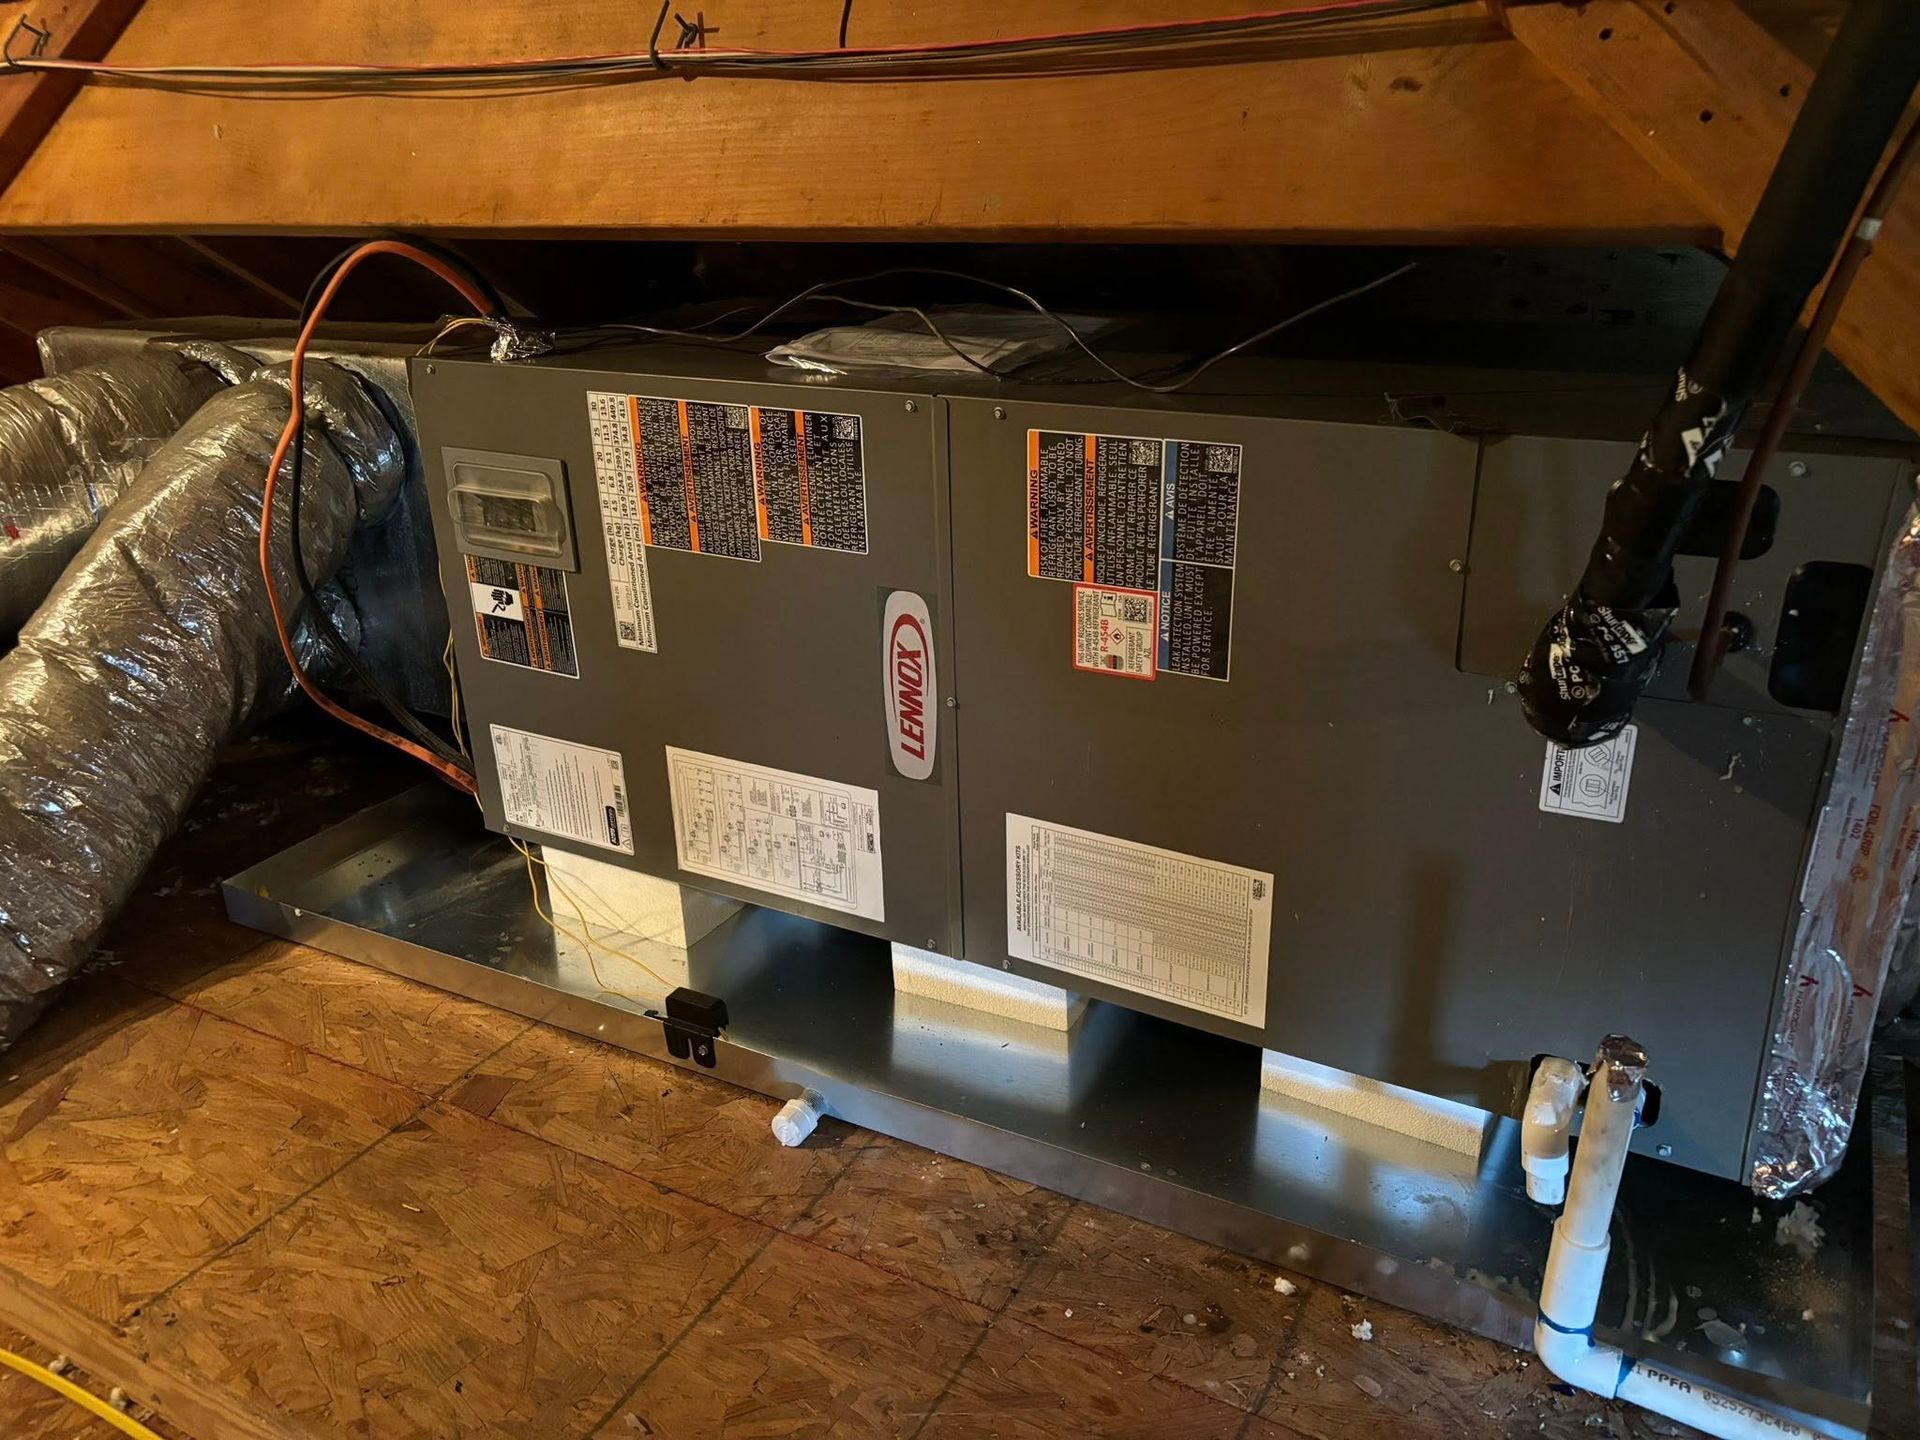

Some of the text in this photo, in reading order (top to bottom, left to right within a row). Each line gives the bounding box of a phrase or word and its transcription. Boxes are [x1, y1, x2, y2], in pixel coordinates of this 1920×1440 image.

[608, 397, 617, 419] 449.8
[618, 401, 626, 418] 41.8
[611, 422, 619, 444] 374.8
[1065, 438, 1073, 457] NOT
[614, 447, 622, 469] 299.9
[623, 451, 631, 468] 27.9
[634, 443, 646, 496] WARNING
[753, 442, 764, 495] WARNING
[1065, 461, 1073, 475] DO
[590, 401, 616, 564] Charge (lb) 10 15 20 25 30
[617, 472, 625, 493] 224.9
[682, 434, 695, 512] AVERTISSEMENT
[797, 432, 808, 514] AVERTISSEMENT
[1057, 491, 1064, 502] BY
[1085, 458, 1094, 549] AVERTISSEMENT
[1136, 466, 1146, 513] PERFORER
[620, 496, 628, 516] 149.9
[629, 500, 637, 516] 13.9
[1048, 444, 1056, 576] REFRIGERANT USED. TO BE
[1056, 507, 1064, 531] ONLY
[1065, 479, 1073, 538] PERSONNEL.
[1074, 436, 1083, 579] PUNCTURE REFRIGERANT TUBING.
[1104, 440, 1117, 584] UTILISÉ INFLAMMABLE. SEUL
[1145, 478, 1157, 548] RÉFRIGÉRANT.
[614, 522, 622, 536] (kg)
[623, 522, 632, 540] (ft2)
[631, 522, 641, 541] (m2)
[1124, 468, 1136, 586] FORMÉ PEUT RÉPARER CE
[1136, 515, 1145, 532] PAS
[616, 537, 626, 566] Charge
[634, 541, 642, 560] Area
[1040, 538, 1047, 552] OF
[1116, 513, 1125, 569] PERSONNEL
[1136, 534, 1144, 546] NE
[1096, 553, 1106, 582] RISQUE
[1115, 571, 1124, 585] UN
[1146, 553, 1155, 576] TUBE
[1184, 565, 1194, 592] MUST
[628, 561, 640, 608] Conditioned
[637, 561, 649, 609] Conditioned
[1145, 579, 1154, 589] LE
[1160, 590, 1170, 630] NOTICE
[1171, 563, 1184, 670] LEAK DETECTION SYSTEM
[1191, 566, 1204, 673] BE POWERED EXCEPT
[634, 609, 644, 645] Minimum
[643, 610, 653, 647] Minimum
[1200, 605, 1212, 675] FOR SERVICE.
[1569, 665, 1583, 682] PC
[896, 641, 925, 760] LENNOX
[1553, 749, 1566, 784] IMPORT
[1850, 818, 1863, 840] 1402
[1861, 804, 1881, 856] FOIL-GRIP
[1647, 1368, 1691, 1394] PPFA
